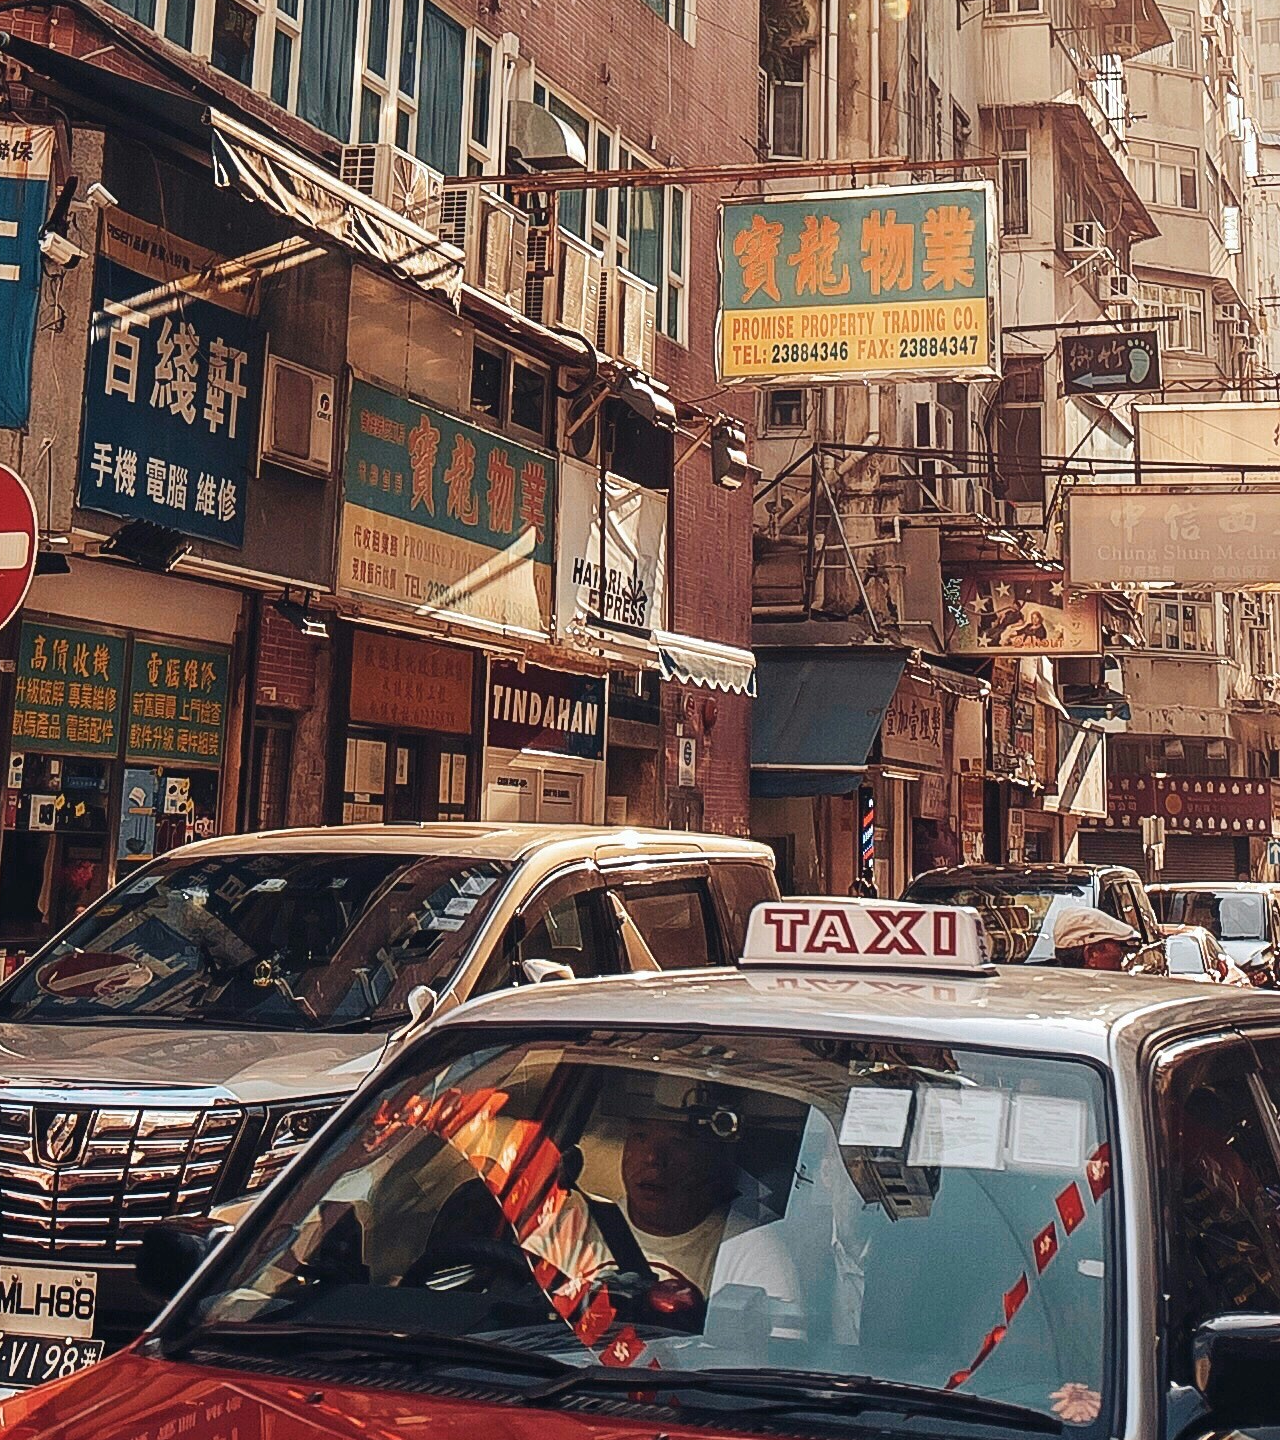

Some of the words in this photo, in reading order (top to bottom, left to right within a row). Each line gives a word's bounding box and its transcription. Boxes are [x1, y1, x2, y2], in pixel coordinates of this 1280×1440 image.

[733, 206, 976, 304] 寶龍物業
[733, 315, 794, 340] PROMISE
[801, 311, 875, 337] PROPERTY
[883, 308, 946, 334] TRADING
[953, 306, 978, 330] CO.
[733, 345, 767, 365] TEL:
[772, 341, 848, 363] 23884346
[858, 338, 894, 360] FAX:
[900, 336, 978, 358] 23884347
[90, 442, 138, 498] 手機
[146, 456, 188, 511] 電腦
[195, 470, 237, 522] 維修
[1097, 545, 1157, 563] Chung
[1164, 545, 1210, 561] Shun
[493, 684, 598, 735] TINDAHAN
[765, 908, 957, 956] TAXI
